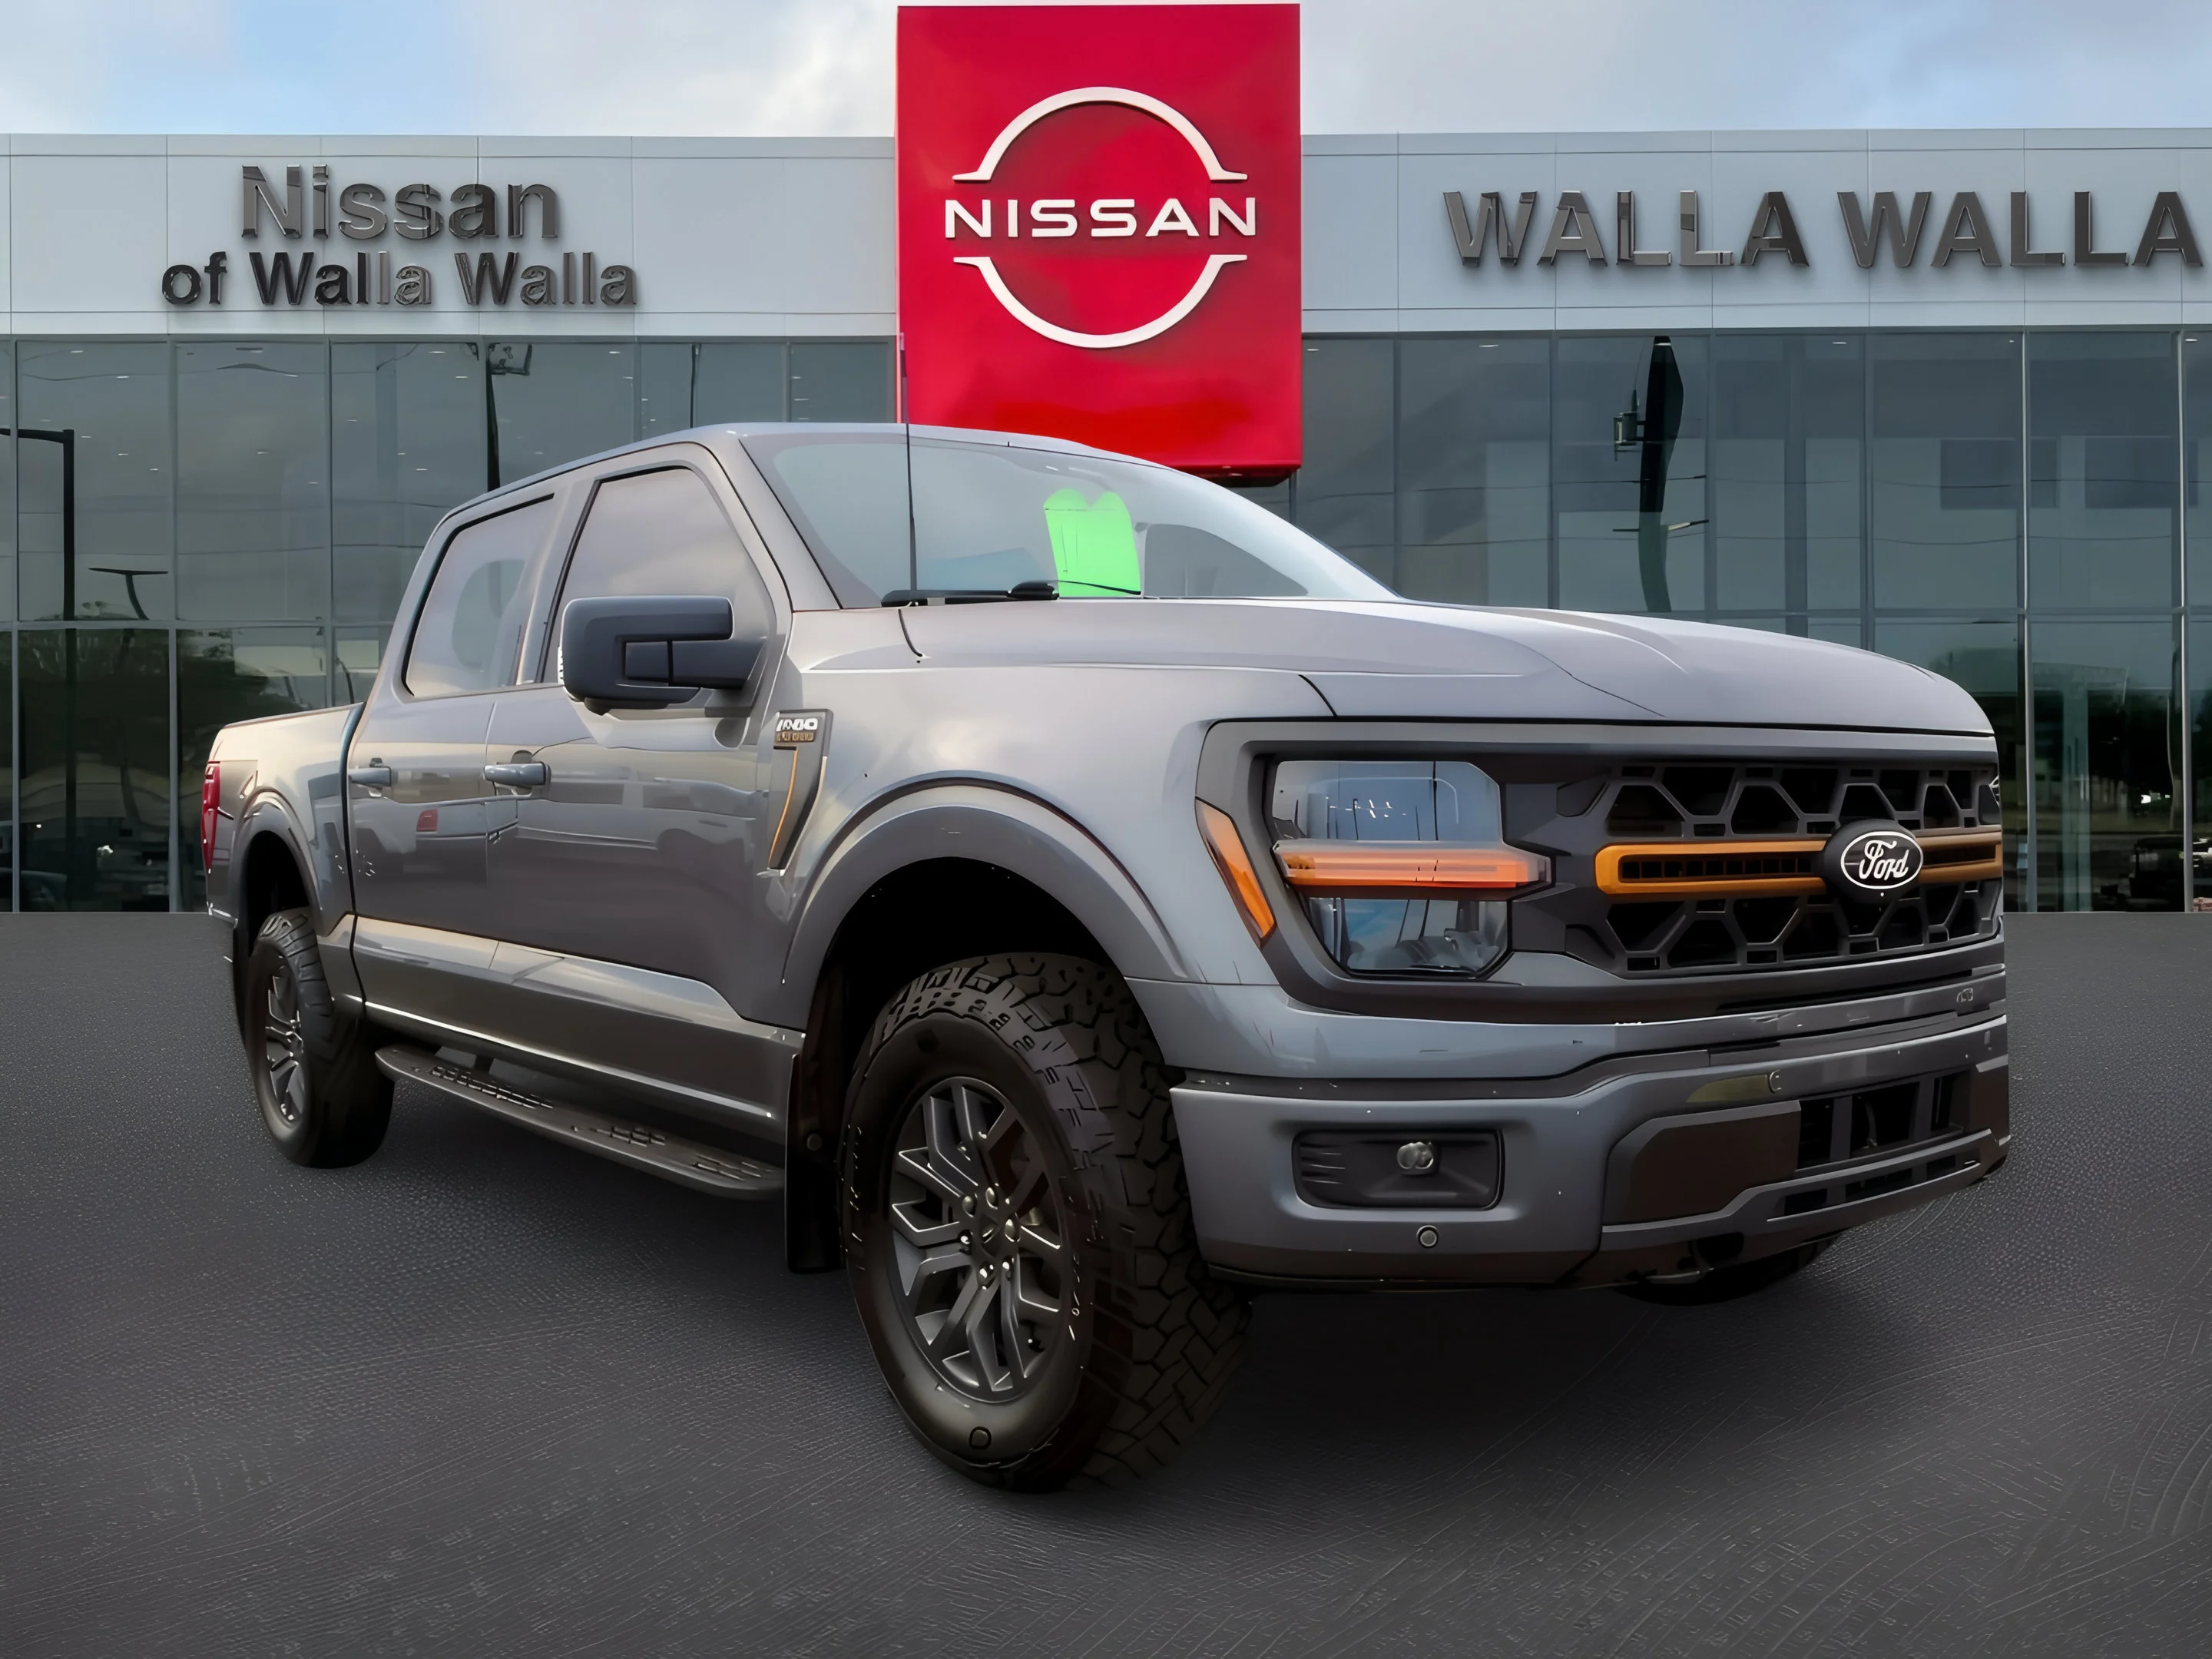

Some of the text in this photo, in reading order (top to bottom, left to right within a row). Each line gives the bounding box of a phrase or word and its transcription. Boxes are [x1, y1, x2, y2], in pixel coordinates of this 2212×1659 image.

[241, 164, 558, 239] Nissan
[945, 197, 1256, 238] NISSAN
[1442, 190, 2204, 268] WALLA WALLA
[161, 251, 637, 306] of Walla Walla
[1859, 839, 1909, 880] Ford
